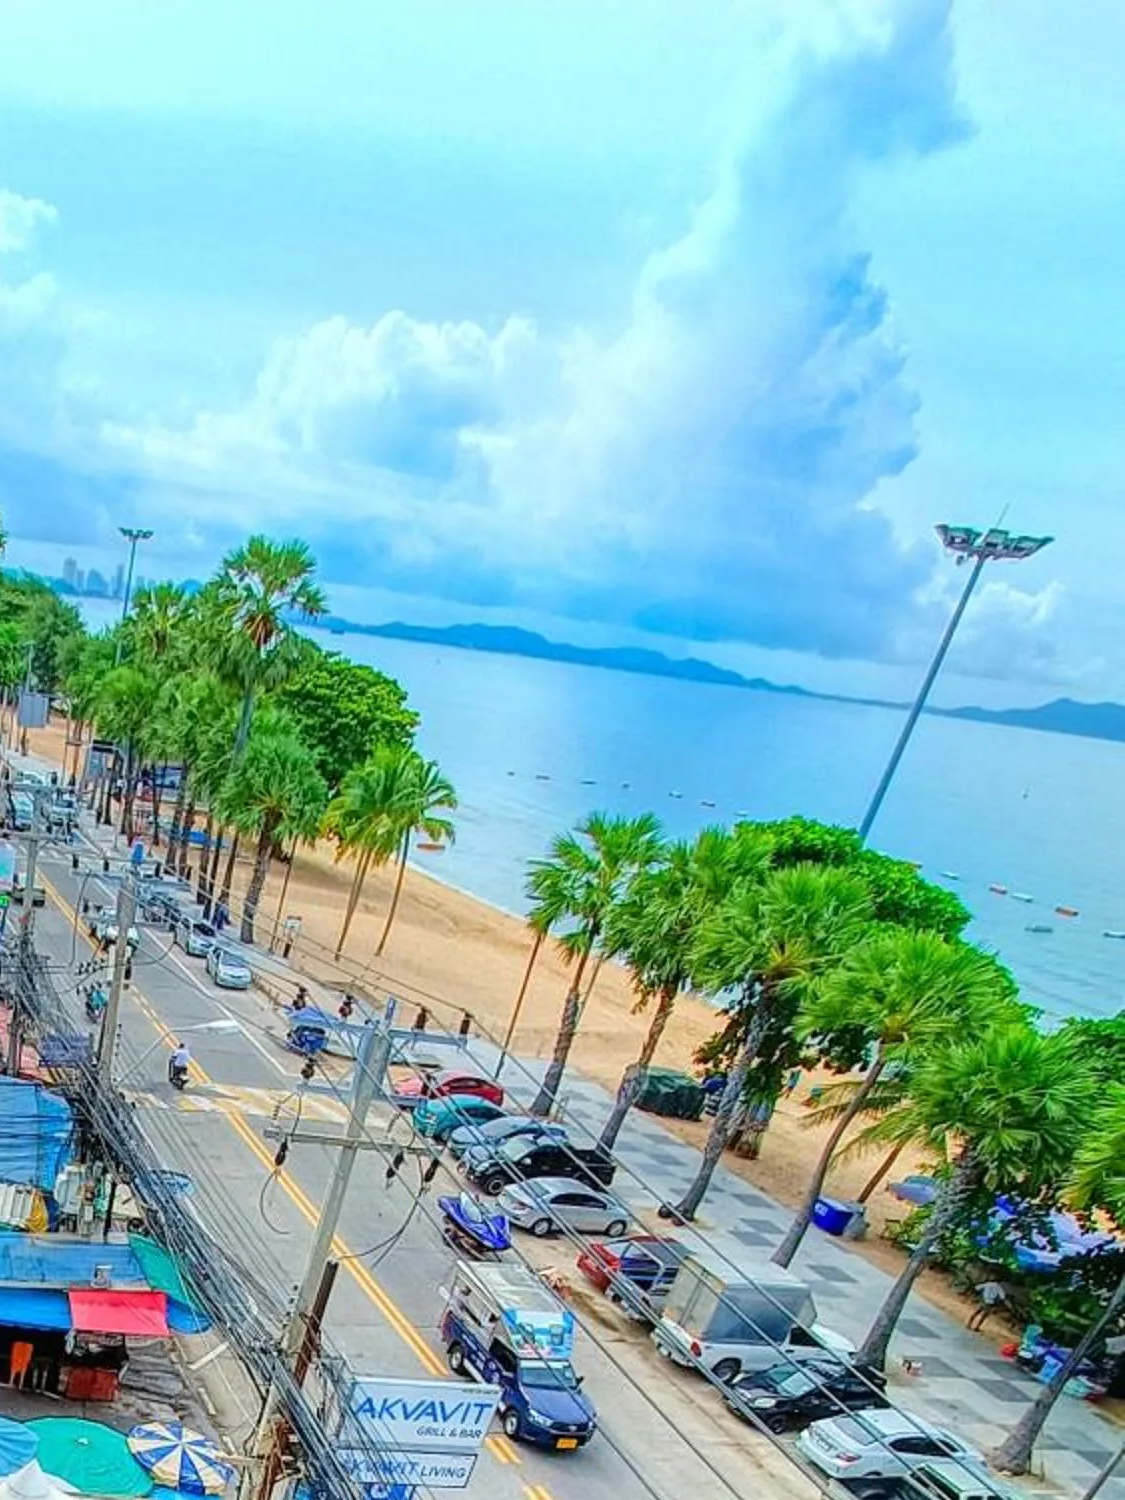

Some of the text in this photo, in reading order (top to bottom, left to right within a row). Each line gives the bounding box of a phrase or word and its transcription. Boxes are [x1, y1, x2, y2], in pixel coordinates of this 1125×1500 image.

[355, 1397, 493, 1425] AKVAVIT
[416, 1425, 446, 1438] GRILL
[459, 1427, 483, 1439] BAR
[420, 1464, 467, 1479] LIVING
